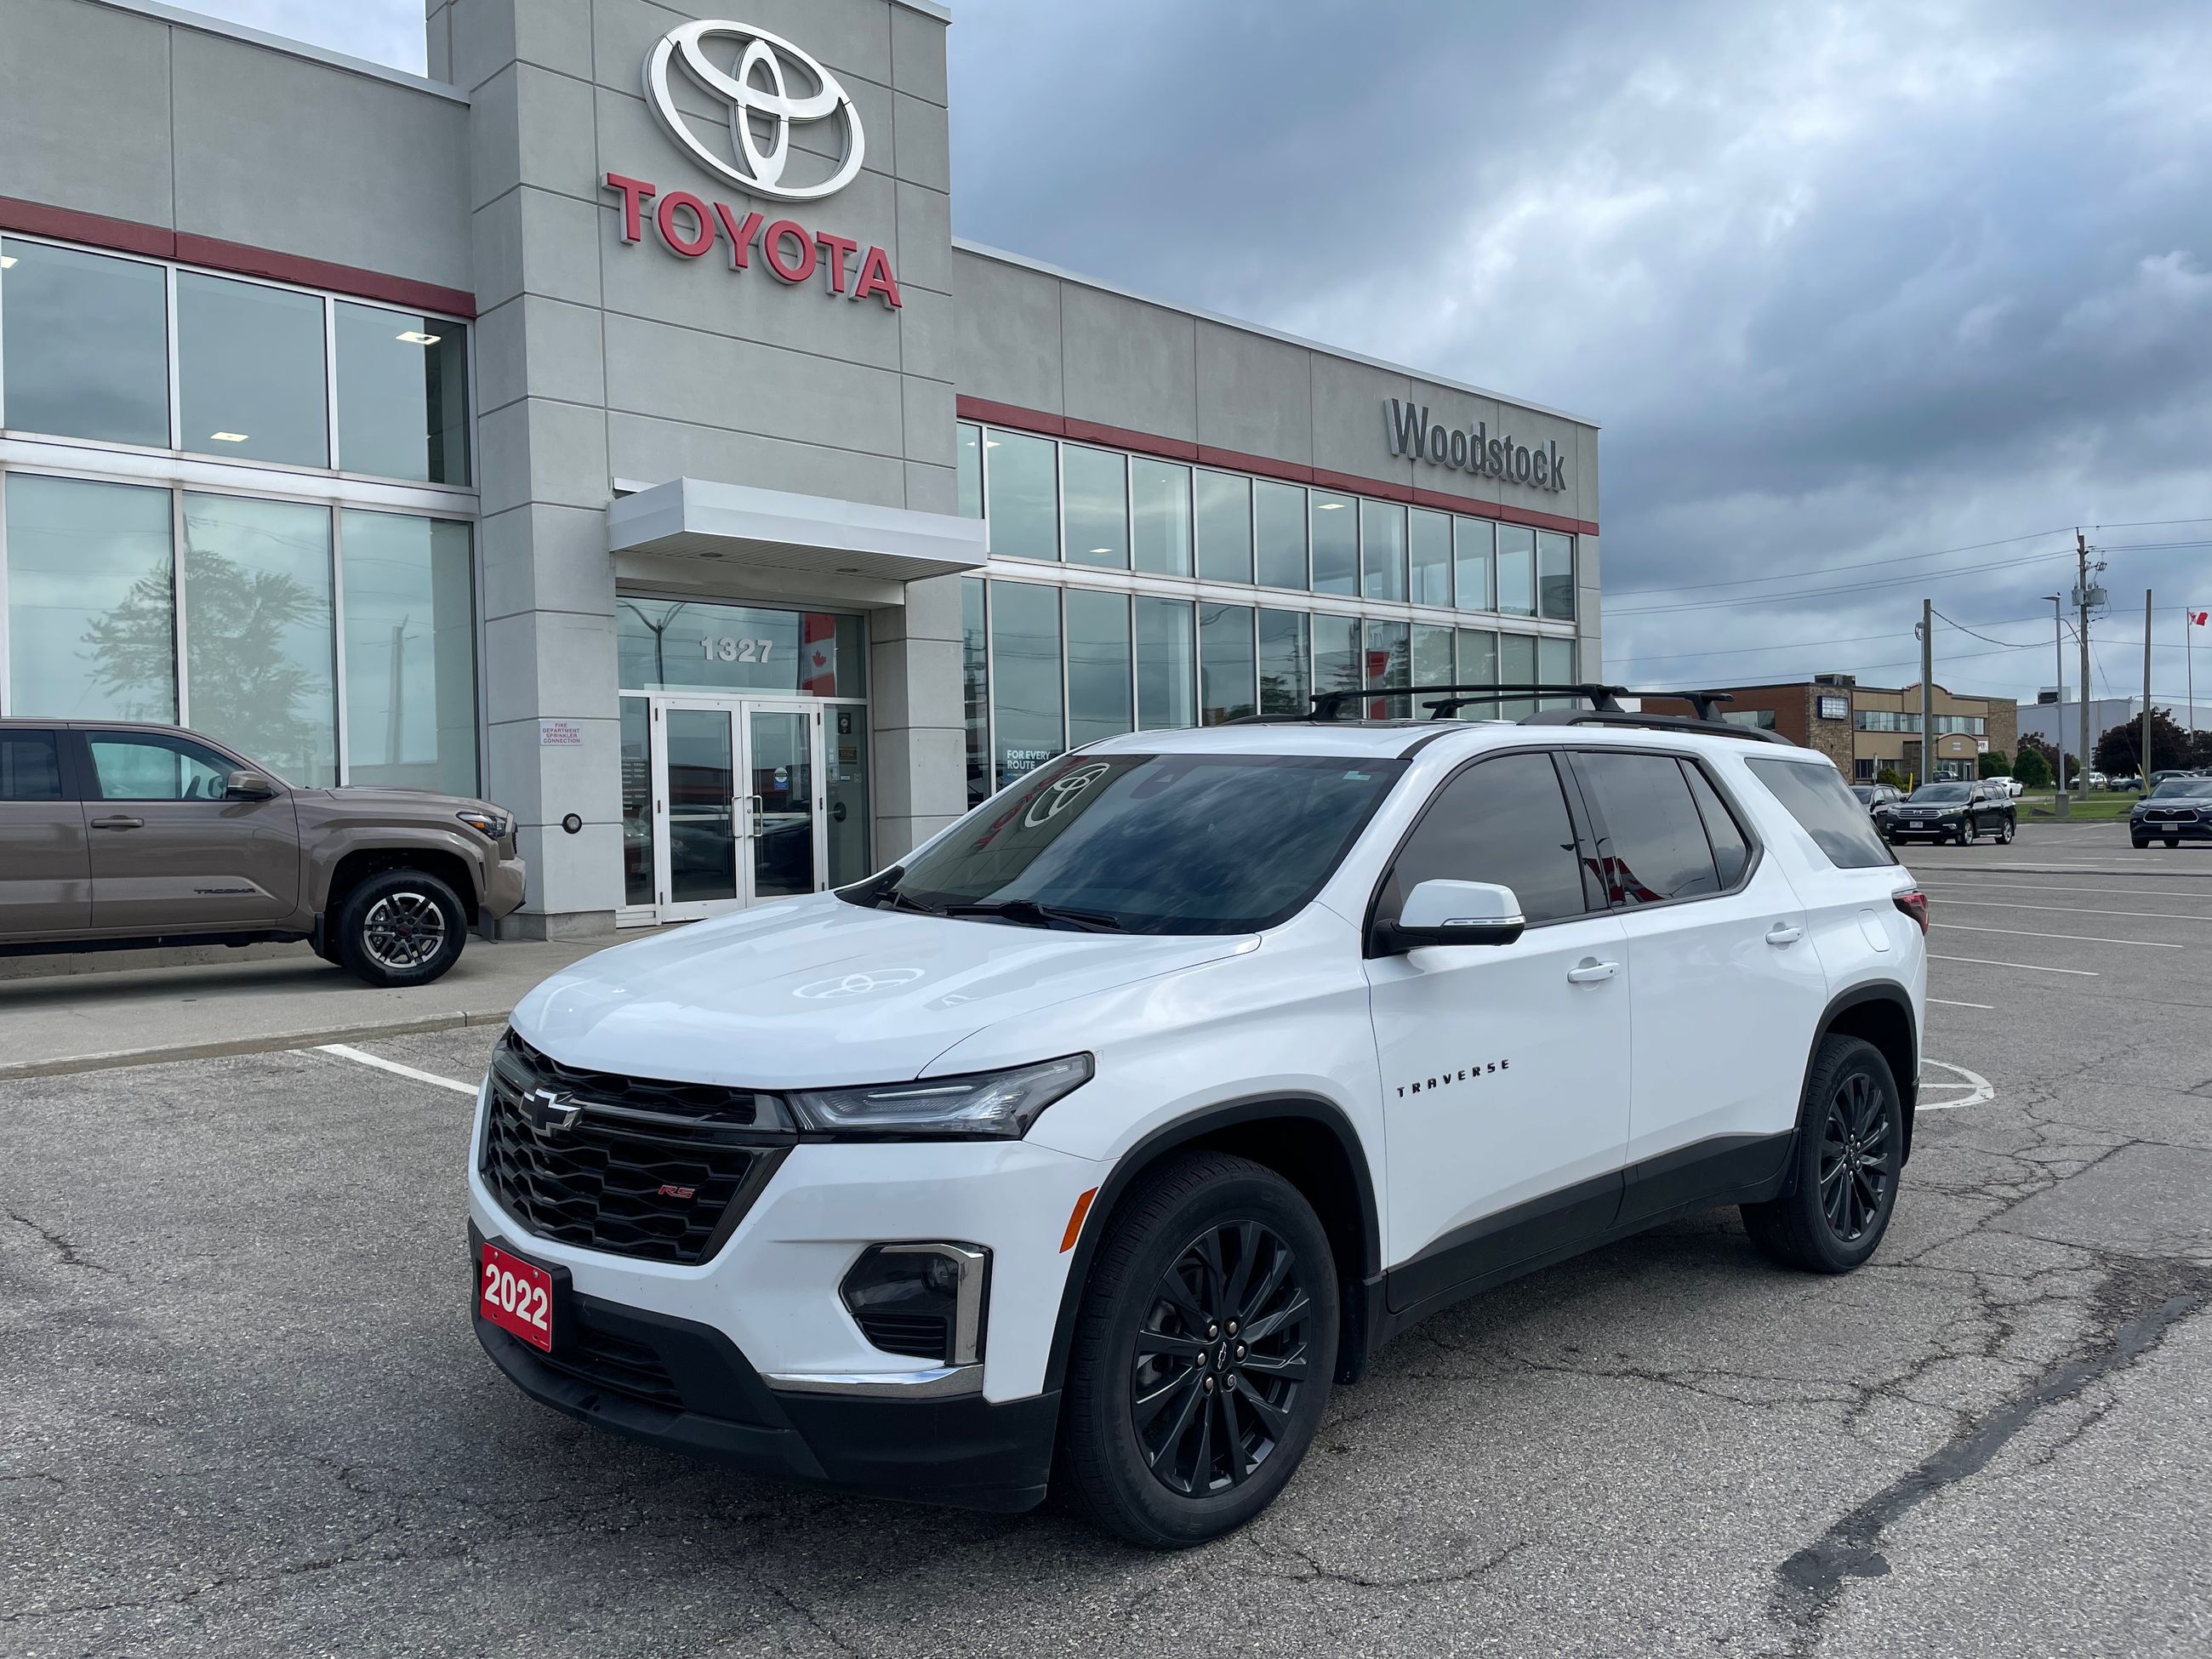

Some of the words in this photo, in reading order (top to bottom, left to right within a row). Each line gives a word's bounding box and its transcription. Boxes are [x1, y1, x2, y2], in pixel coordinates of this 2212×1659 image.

[601, 173, 902, 311] TOYOTA
[1385, 398, 1566, 491] Woodstock
[700, 636, 773, 664] 1327
[1006, 750, 1024, 760] FOR
[1025, 750, 1051, 761] EVERY
[1006, 760, 1035, 769] ROUTE
[1397, 1059, 1509, 1097] TRAVERSE
[658, 1184, 696, 1199] RS
[485, 1263, 548, 1331] 2022
